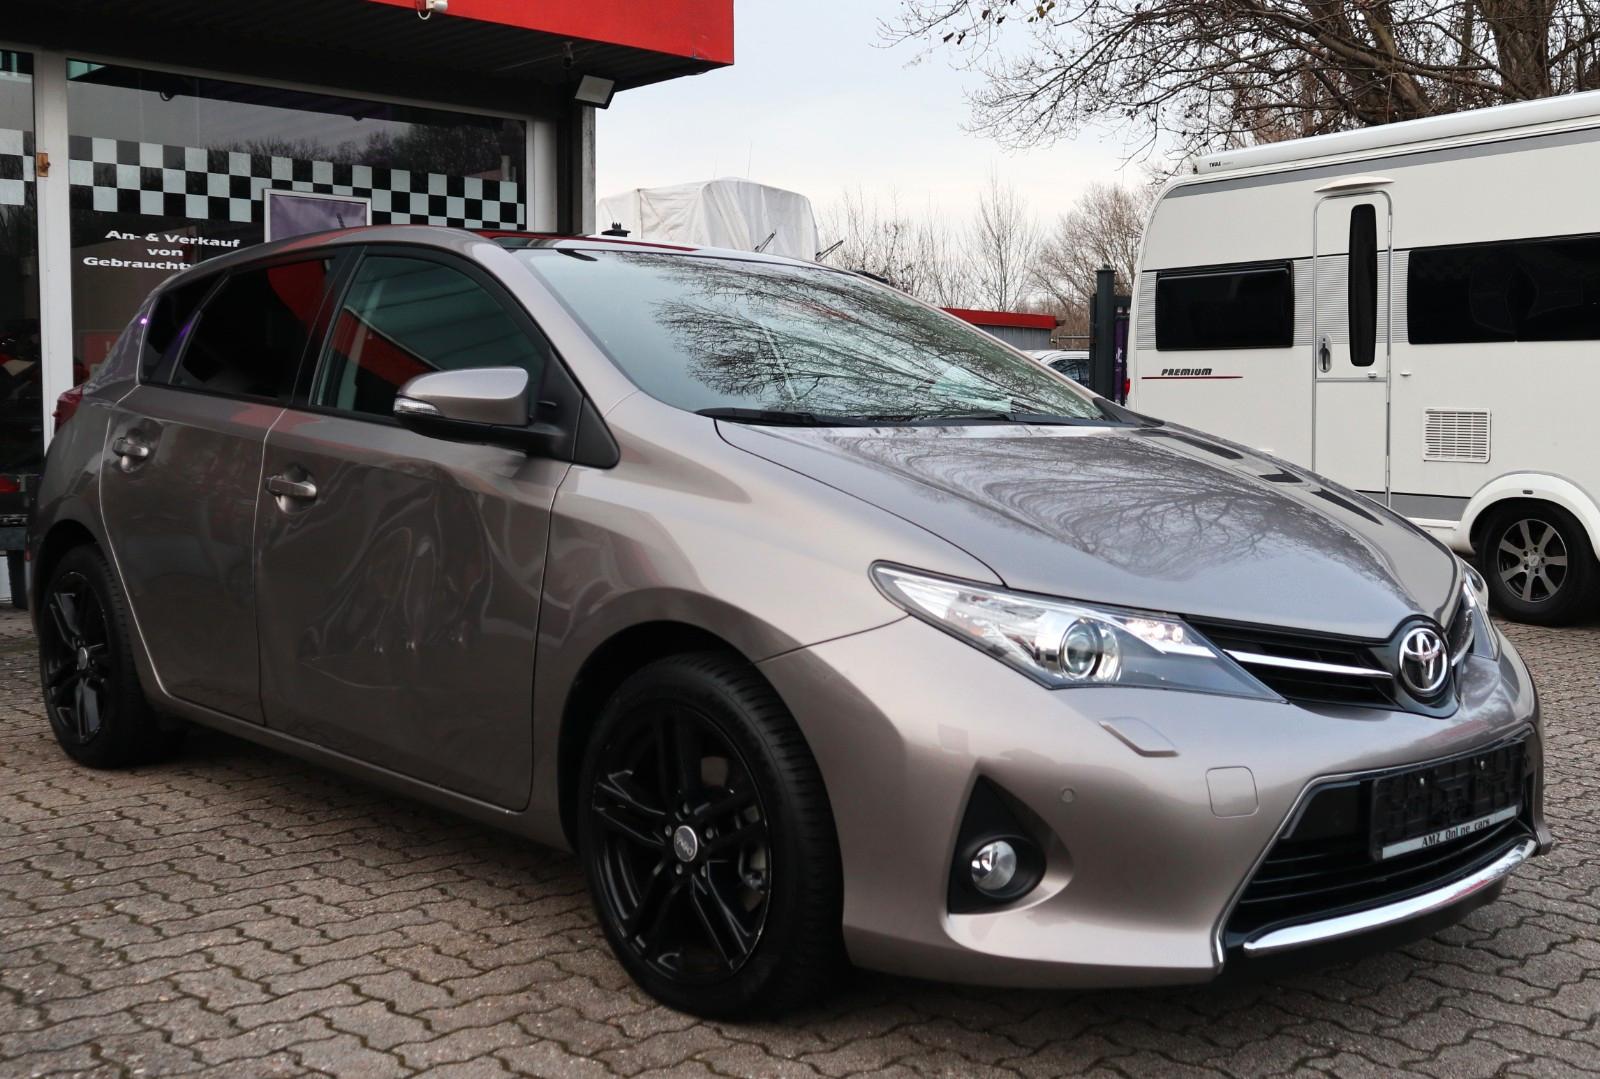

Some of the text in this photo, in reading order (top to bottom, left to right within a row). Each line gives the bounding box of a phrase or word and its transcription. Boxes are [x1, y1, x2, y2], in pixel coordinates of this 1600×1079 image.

[105, 230, 241, 248] An- & Verkauf
[147, 248, 183, 256] von
[83, 257, 192, 271] Gebraucht
[1161, 368, 1212, 376] PREMIUM
[1422, 833, 1440, 848] AMZ
[1445, 825, 1470, 840] Onlne
